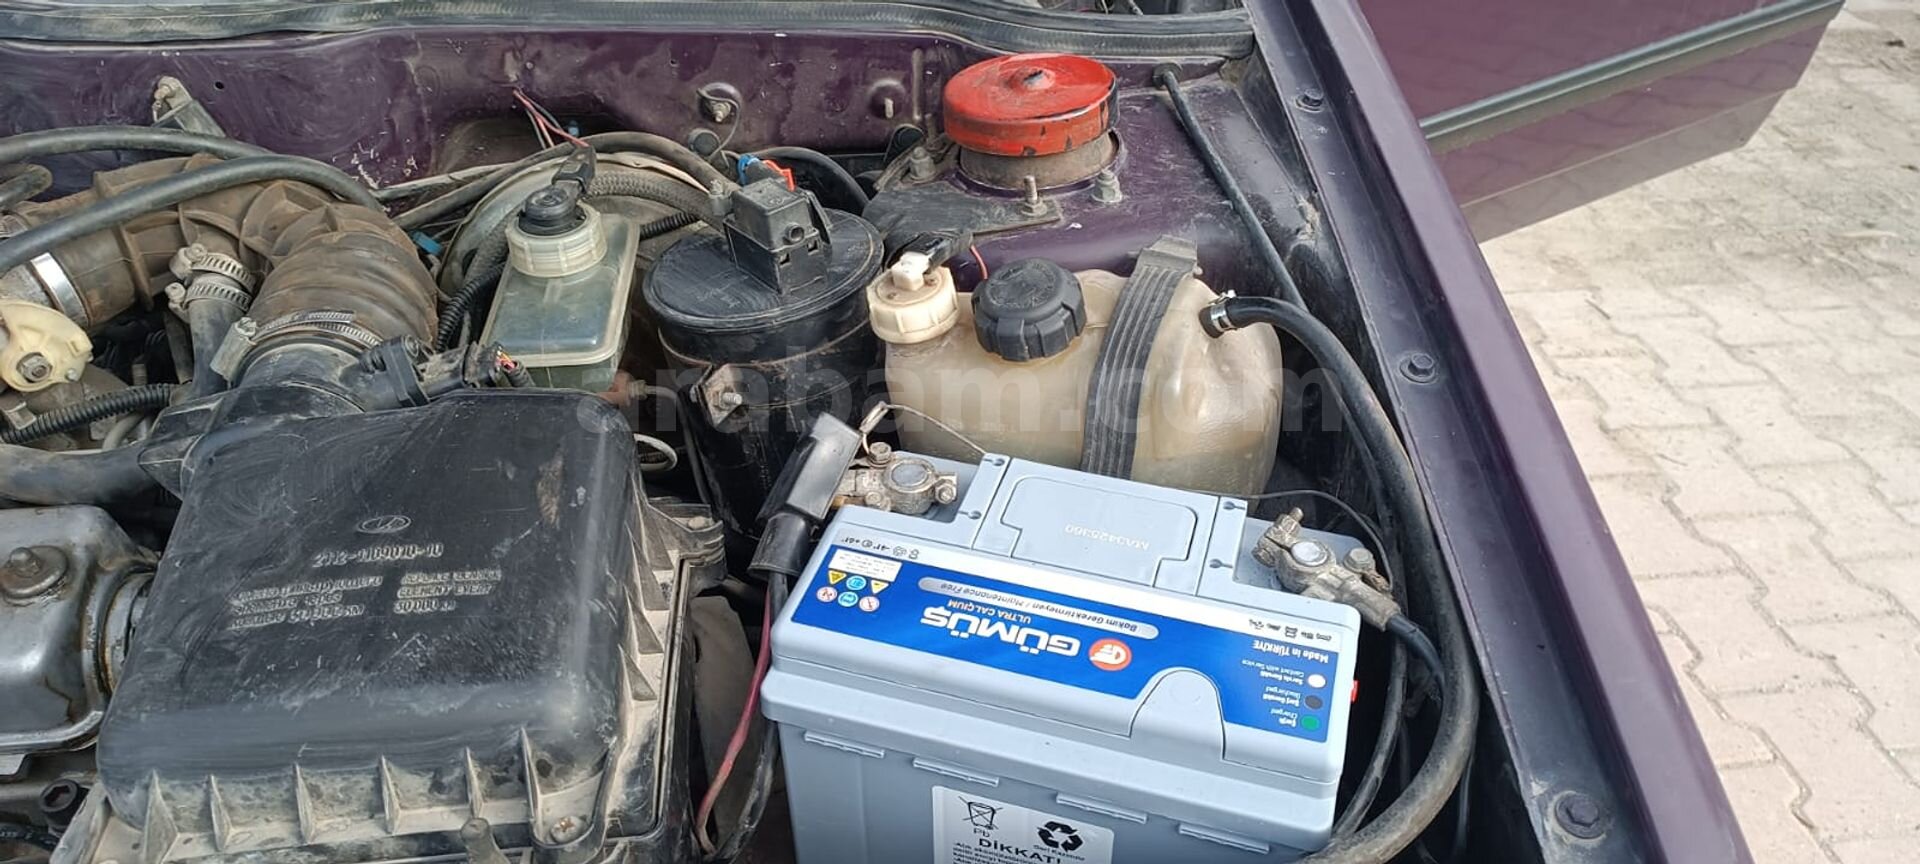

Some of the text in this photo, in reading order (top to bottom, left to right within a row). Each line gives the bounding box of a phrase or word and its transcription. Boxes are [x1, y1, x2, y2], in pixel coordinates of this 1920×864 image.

[941, 582, 963, 595] Free
[997, 608, 1032, 625] ULTRA
[921, 605, 1081, 657] GÜMÜŞ
[1292, 648, 1302, 658] in
[1303, 650, 1329, 663] Made
